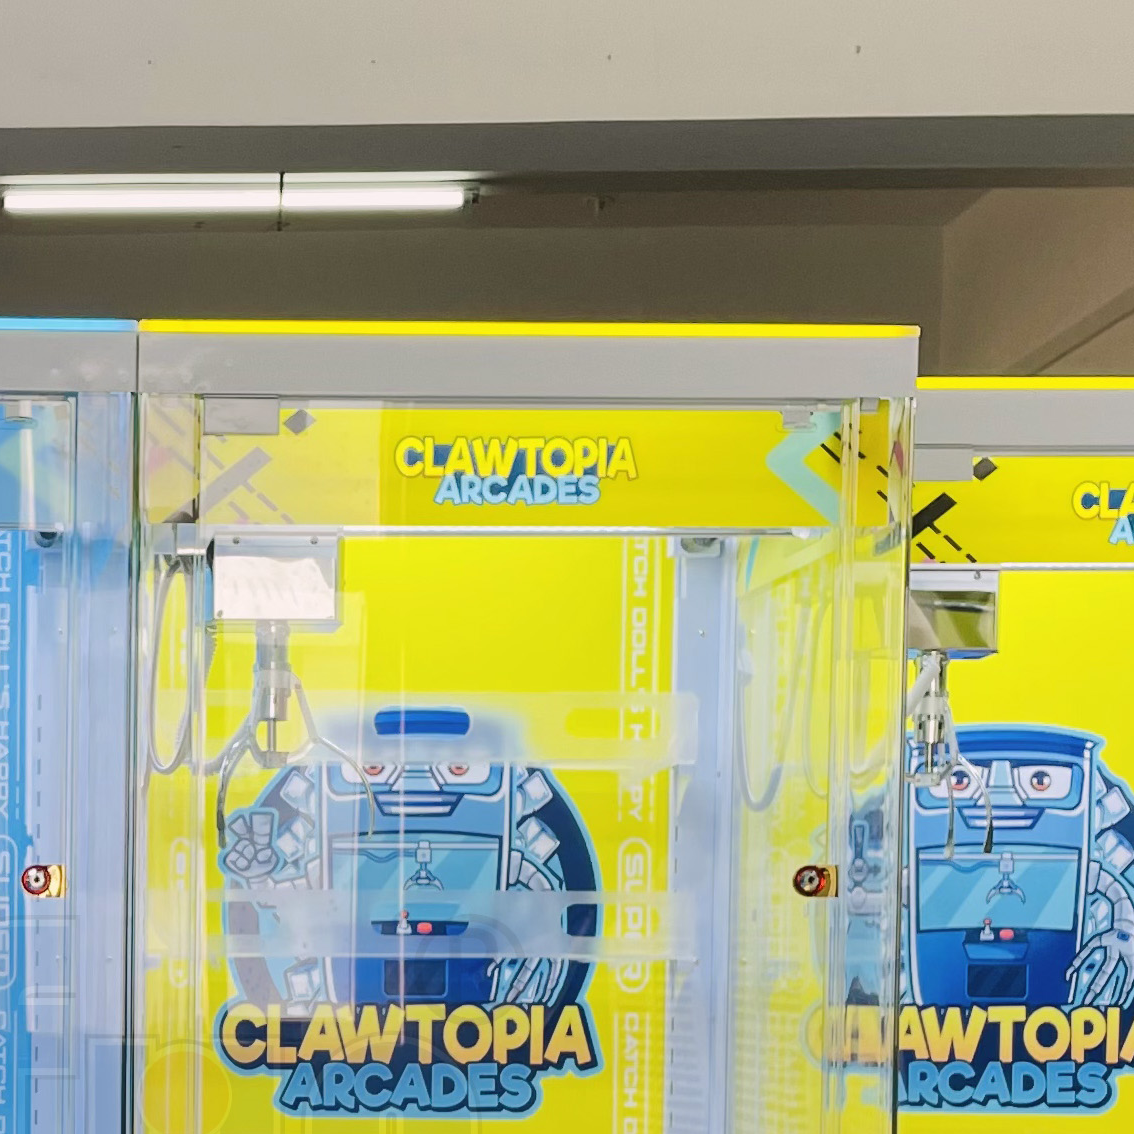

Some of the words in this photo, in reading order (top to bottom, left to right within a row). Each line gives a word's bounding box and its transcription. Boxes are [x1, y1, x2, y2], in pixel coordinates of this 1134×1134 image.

[394, 436, 639, 480] CLAWTOPIA
[433, 474, 601, 505] ARCADES
[633, 537, 648, 597] TCH
[629, 724, 644, 822] HPY
[623, 853, 643, 979] SPR
[220, 1002, 596, 1069] CLAWTOPIA
[624, 1012, 639, 1108] CATCH
[899, 1004, 1134, 1064] AWTOPI
[279, 1061, 536, 1112] ARCADES
[899, 1060, 1113, 1107] RCADES
